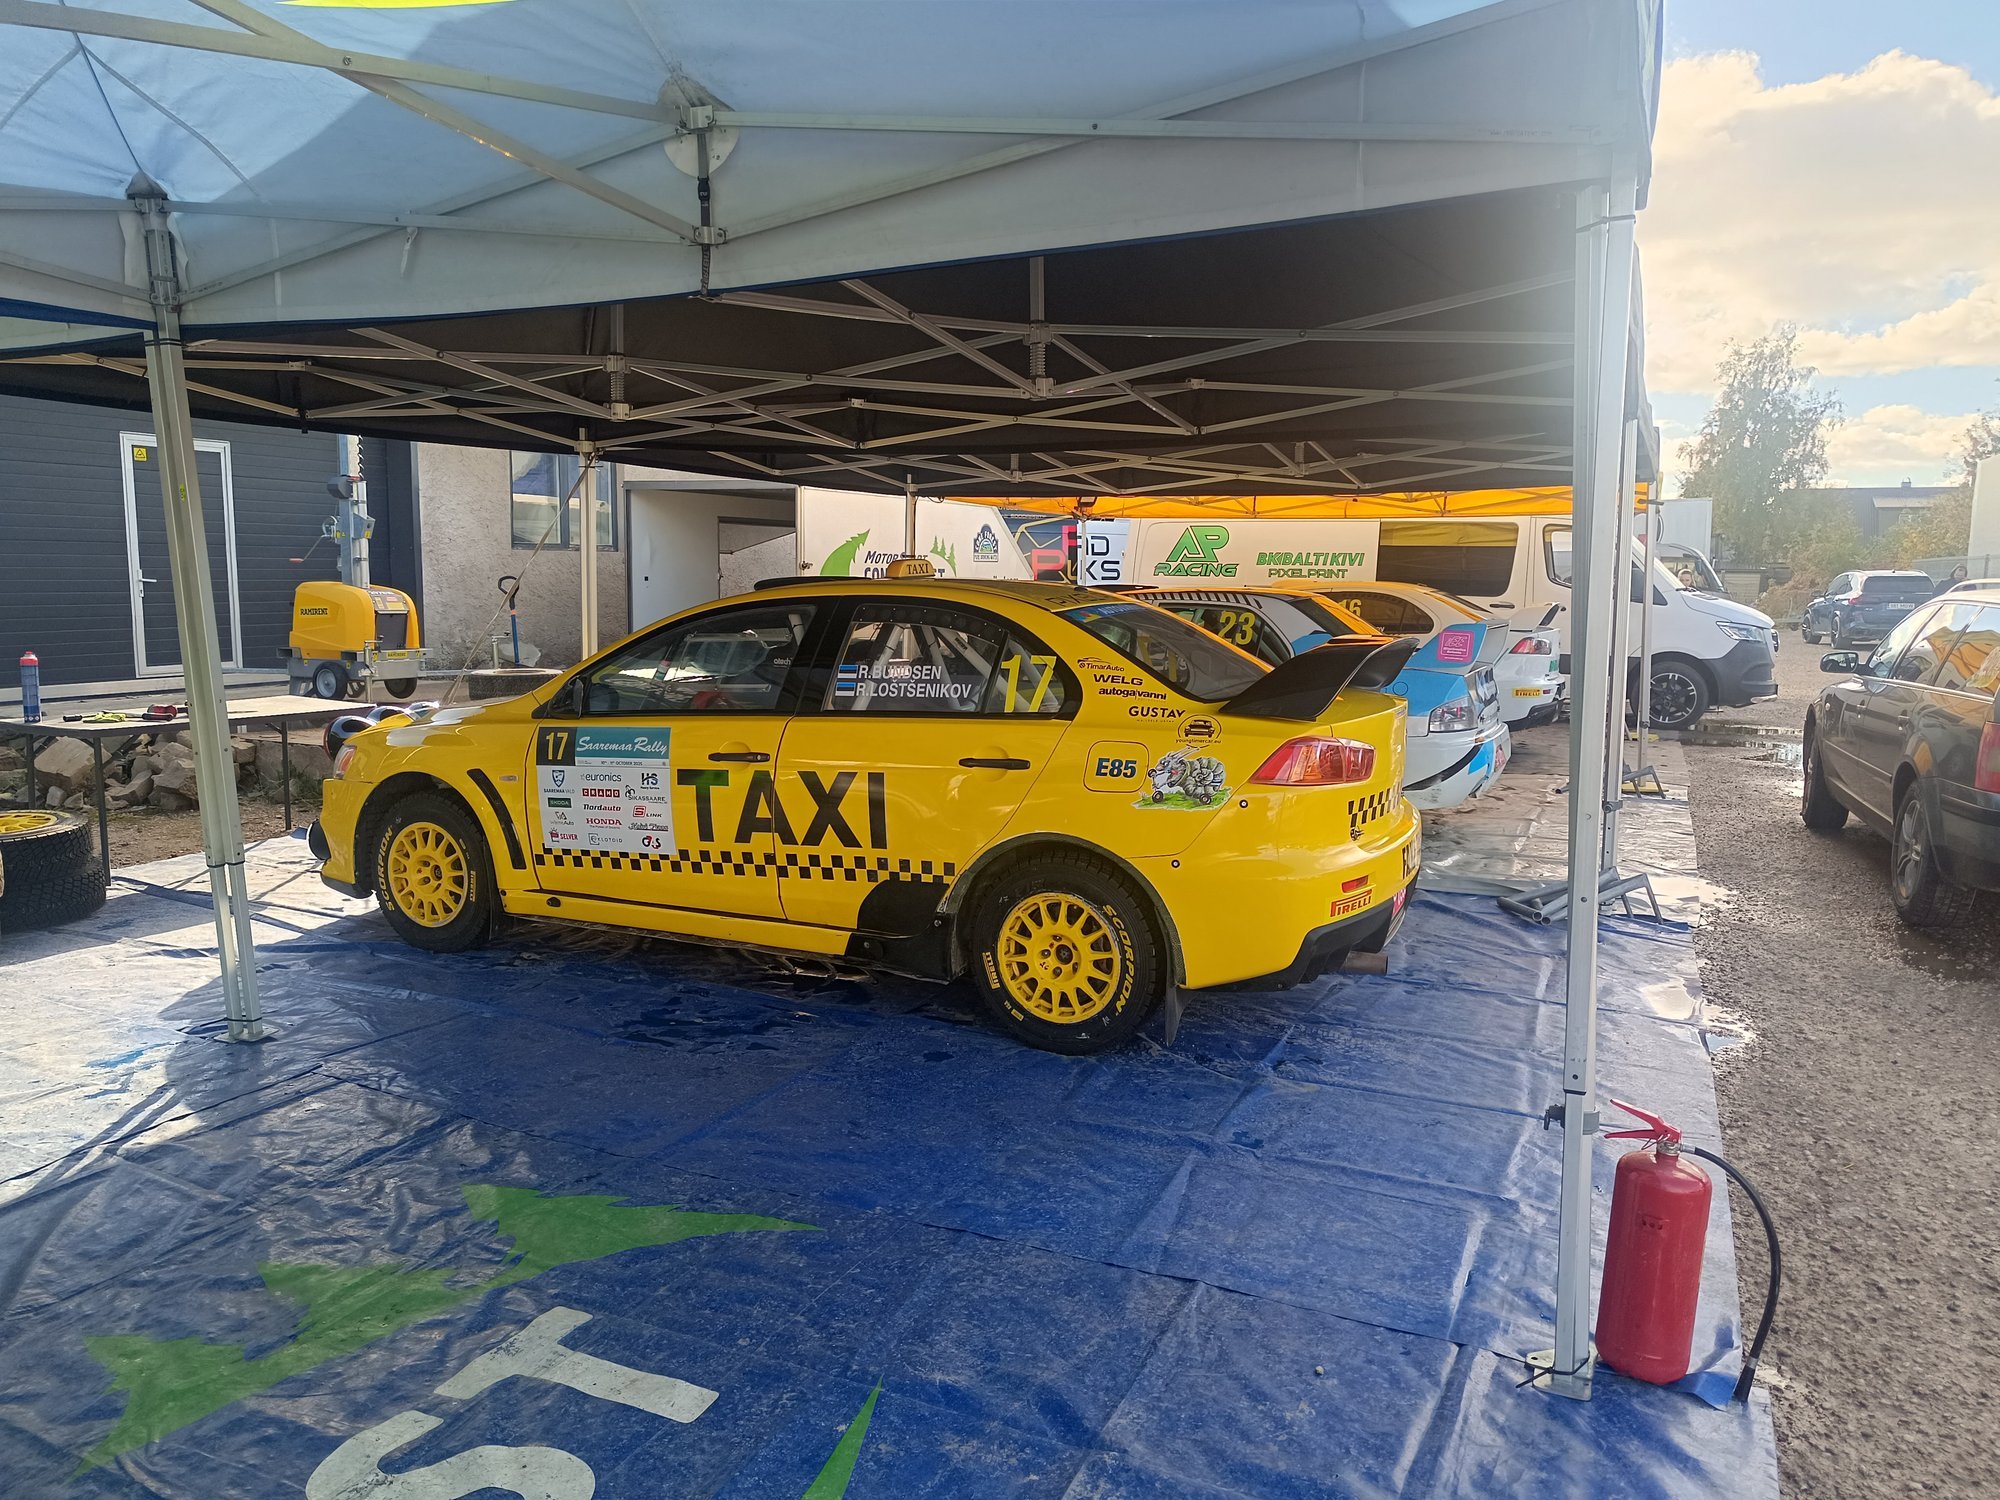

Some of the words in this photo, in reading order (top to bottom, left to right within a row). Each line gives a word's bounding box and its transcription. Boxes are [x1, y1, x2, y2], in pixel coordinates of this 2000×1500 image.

[1165, 525, 1230, 562] AP
[907, 564, 929, 575] TAXI
[1153, 562, 1239, 577] RACING
[1217, 610, 1256, 645] 23
[858, 665, 941, 680] R.BUNDSEN
[1086, 663, 1125, 672] TimarAuto
[1001, 654, 1057, 712] 17
[1093, 674, 1143, 686] WELG
[856, 680, 972, 699] R.LOŠTŠENIKOV
[1129, 706, 1185, 718] GUSTAV
[546, 732, 569, 760] 17
[576, 736, 633, 752] Saaremaa
[633, 737, 667, 756] Rally
[1095, 758, 1137, 778] E85
[585, 772, 621, 782] euronics
[583, 789, 620, 797] CRAMO
[583, 804, 621, 812] Nordauto
[677, 769, 887, 849] TAXI
[586, 818, 622, 826] HONDA
[560, 833, 578, 841] SELVER
[377, 827, 394, 911] SCORPION
[1330, 889, 1373, 917] PIRELLI
[1103, 904, 1135, 1013] SCORPION
